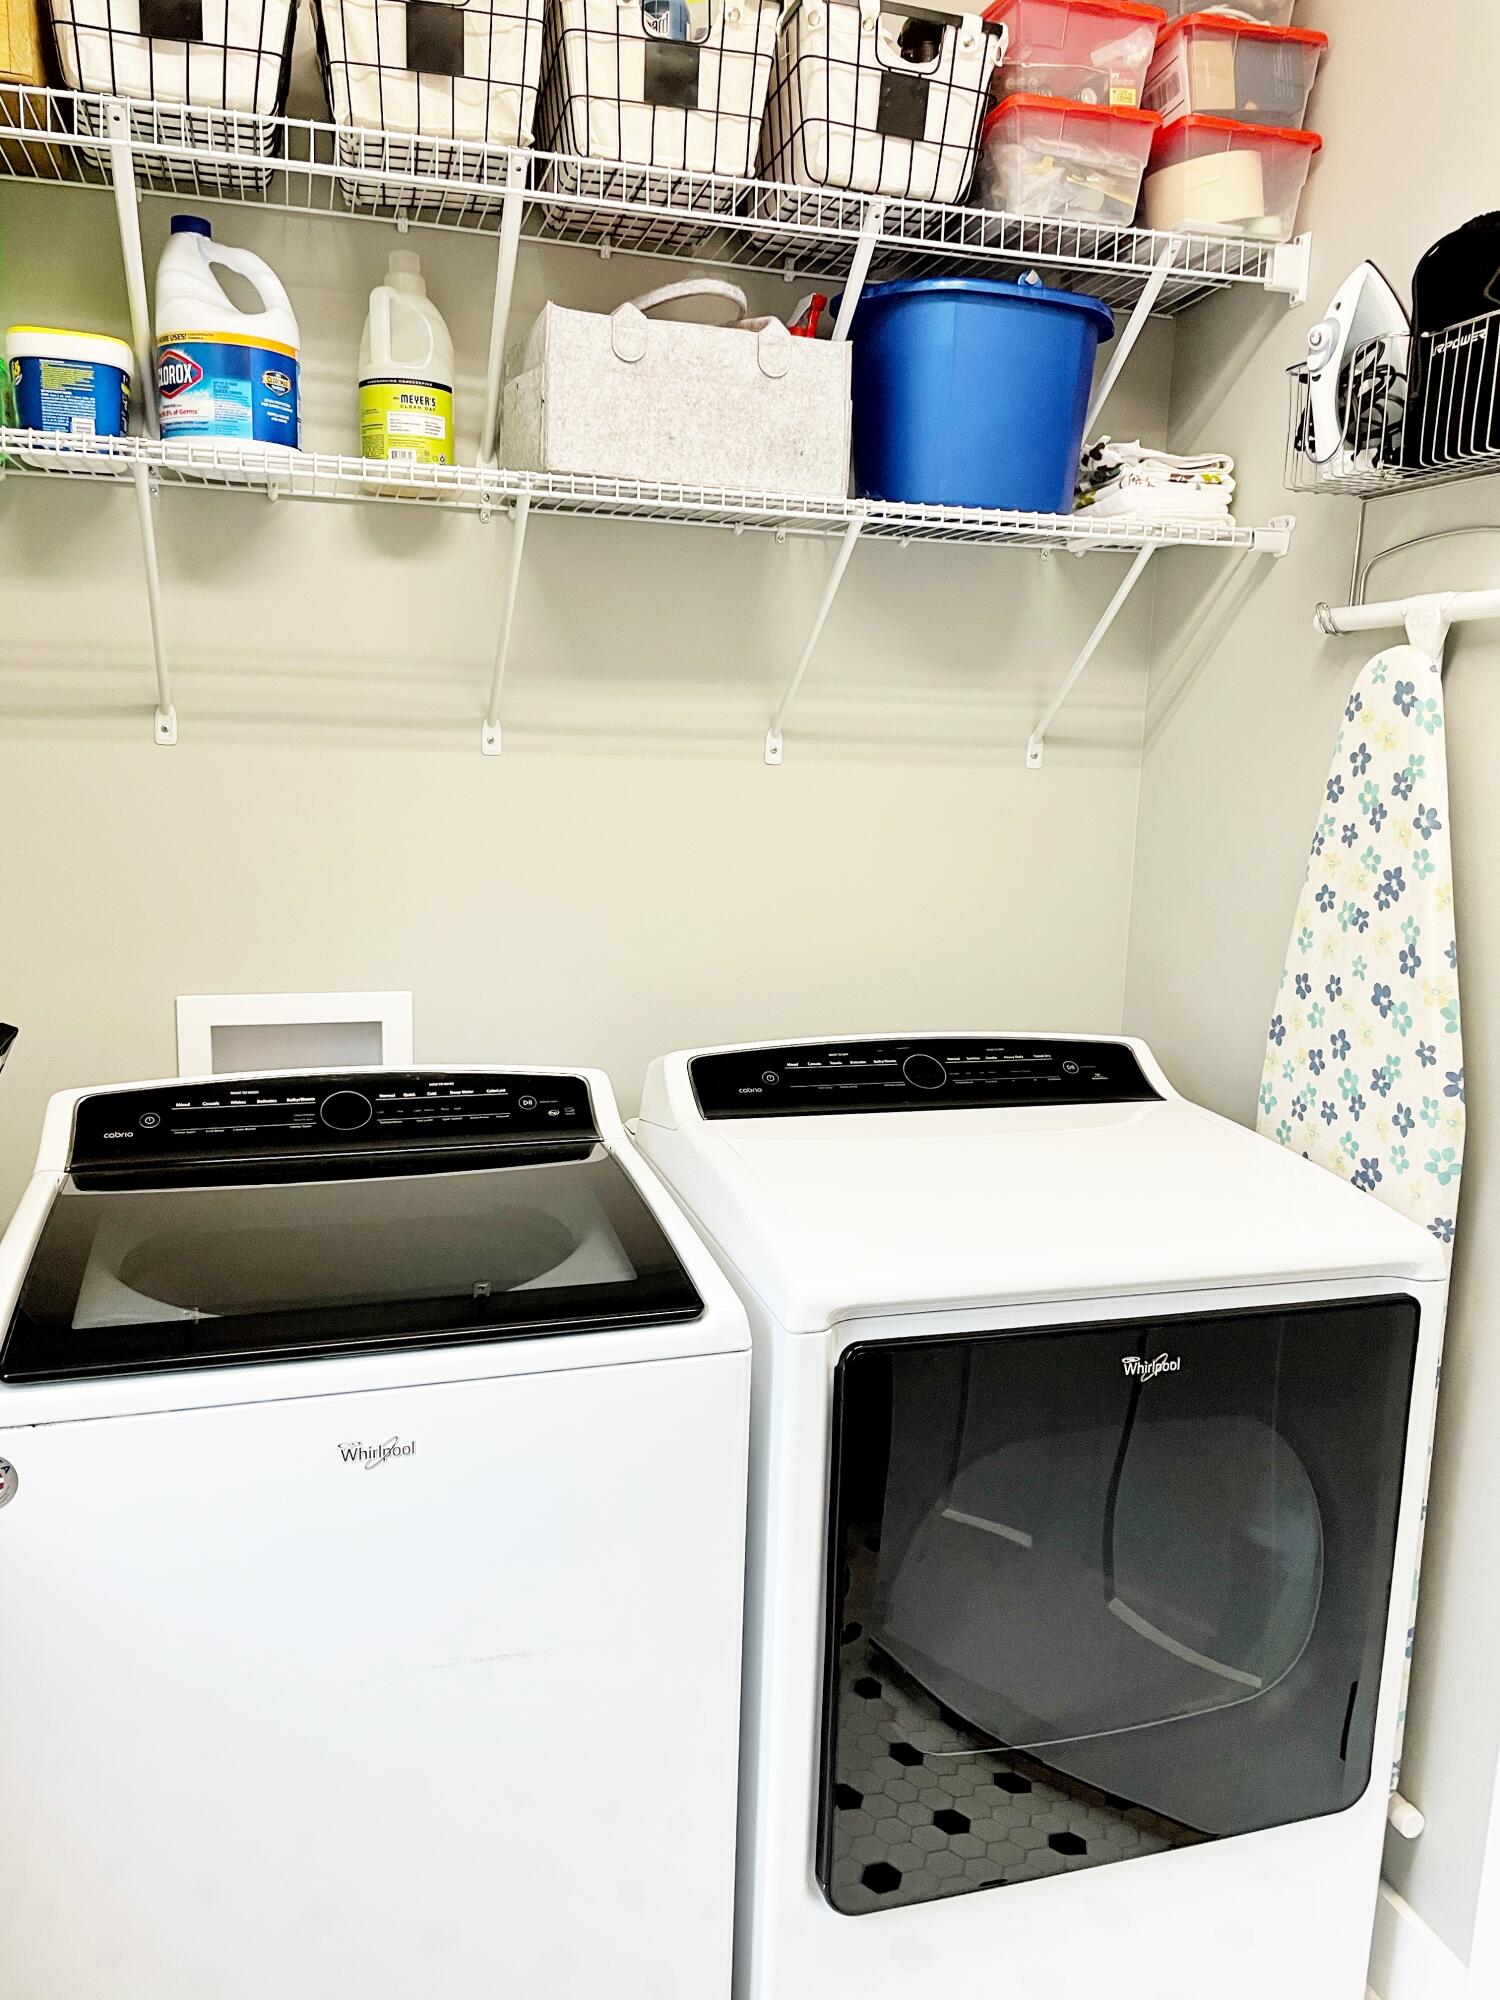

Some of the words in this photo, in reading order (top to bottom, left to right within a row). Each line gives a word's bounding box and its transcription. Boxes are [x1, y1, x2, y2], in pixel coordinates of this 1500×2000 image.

[400, 394, 436, 407] MEYER'S
[103, 1130, 134, 1139] cabrio
[1123, 1355, 1181, 1378] Whirlpool
[340, 1439, 415, 1464] Whirlpool
